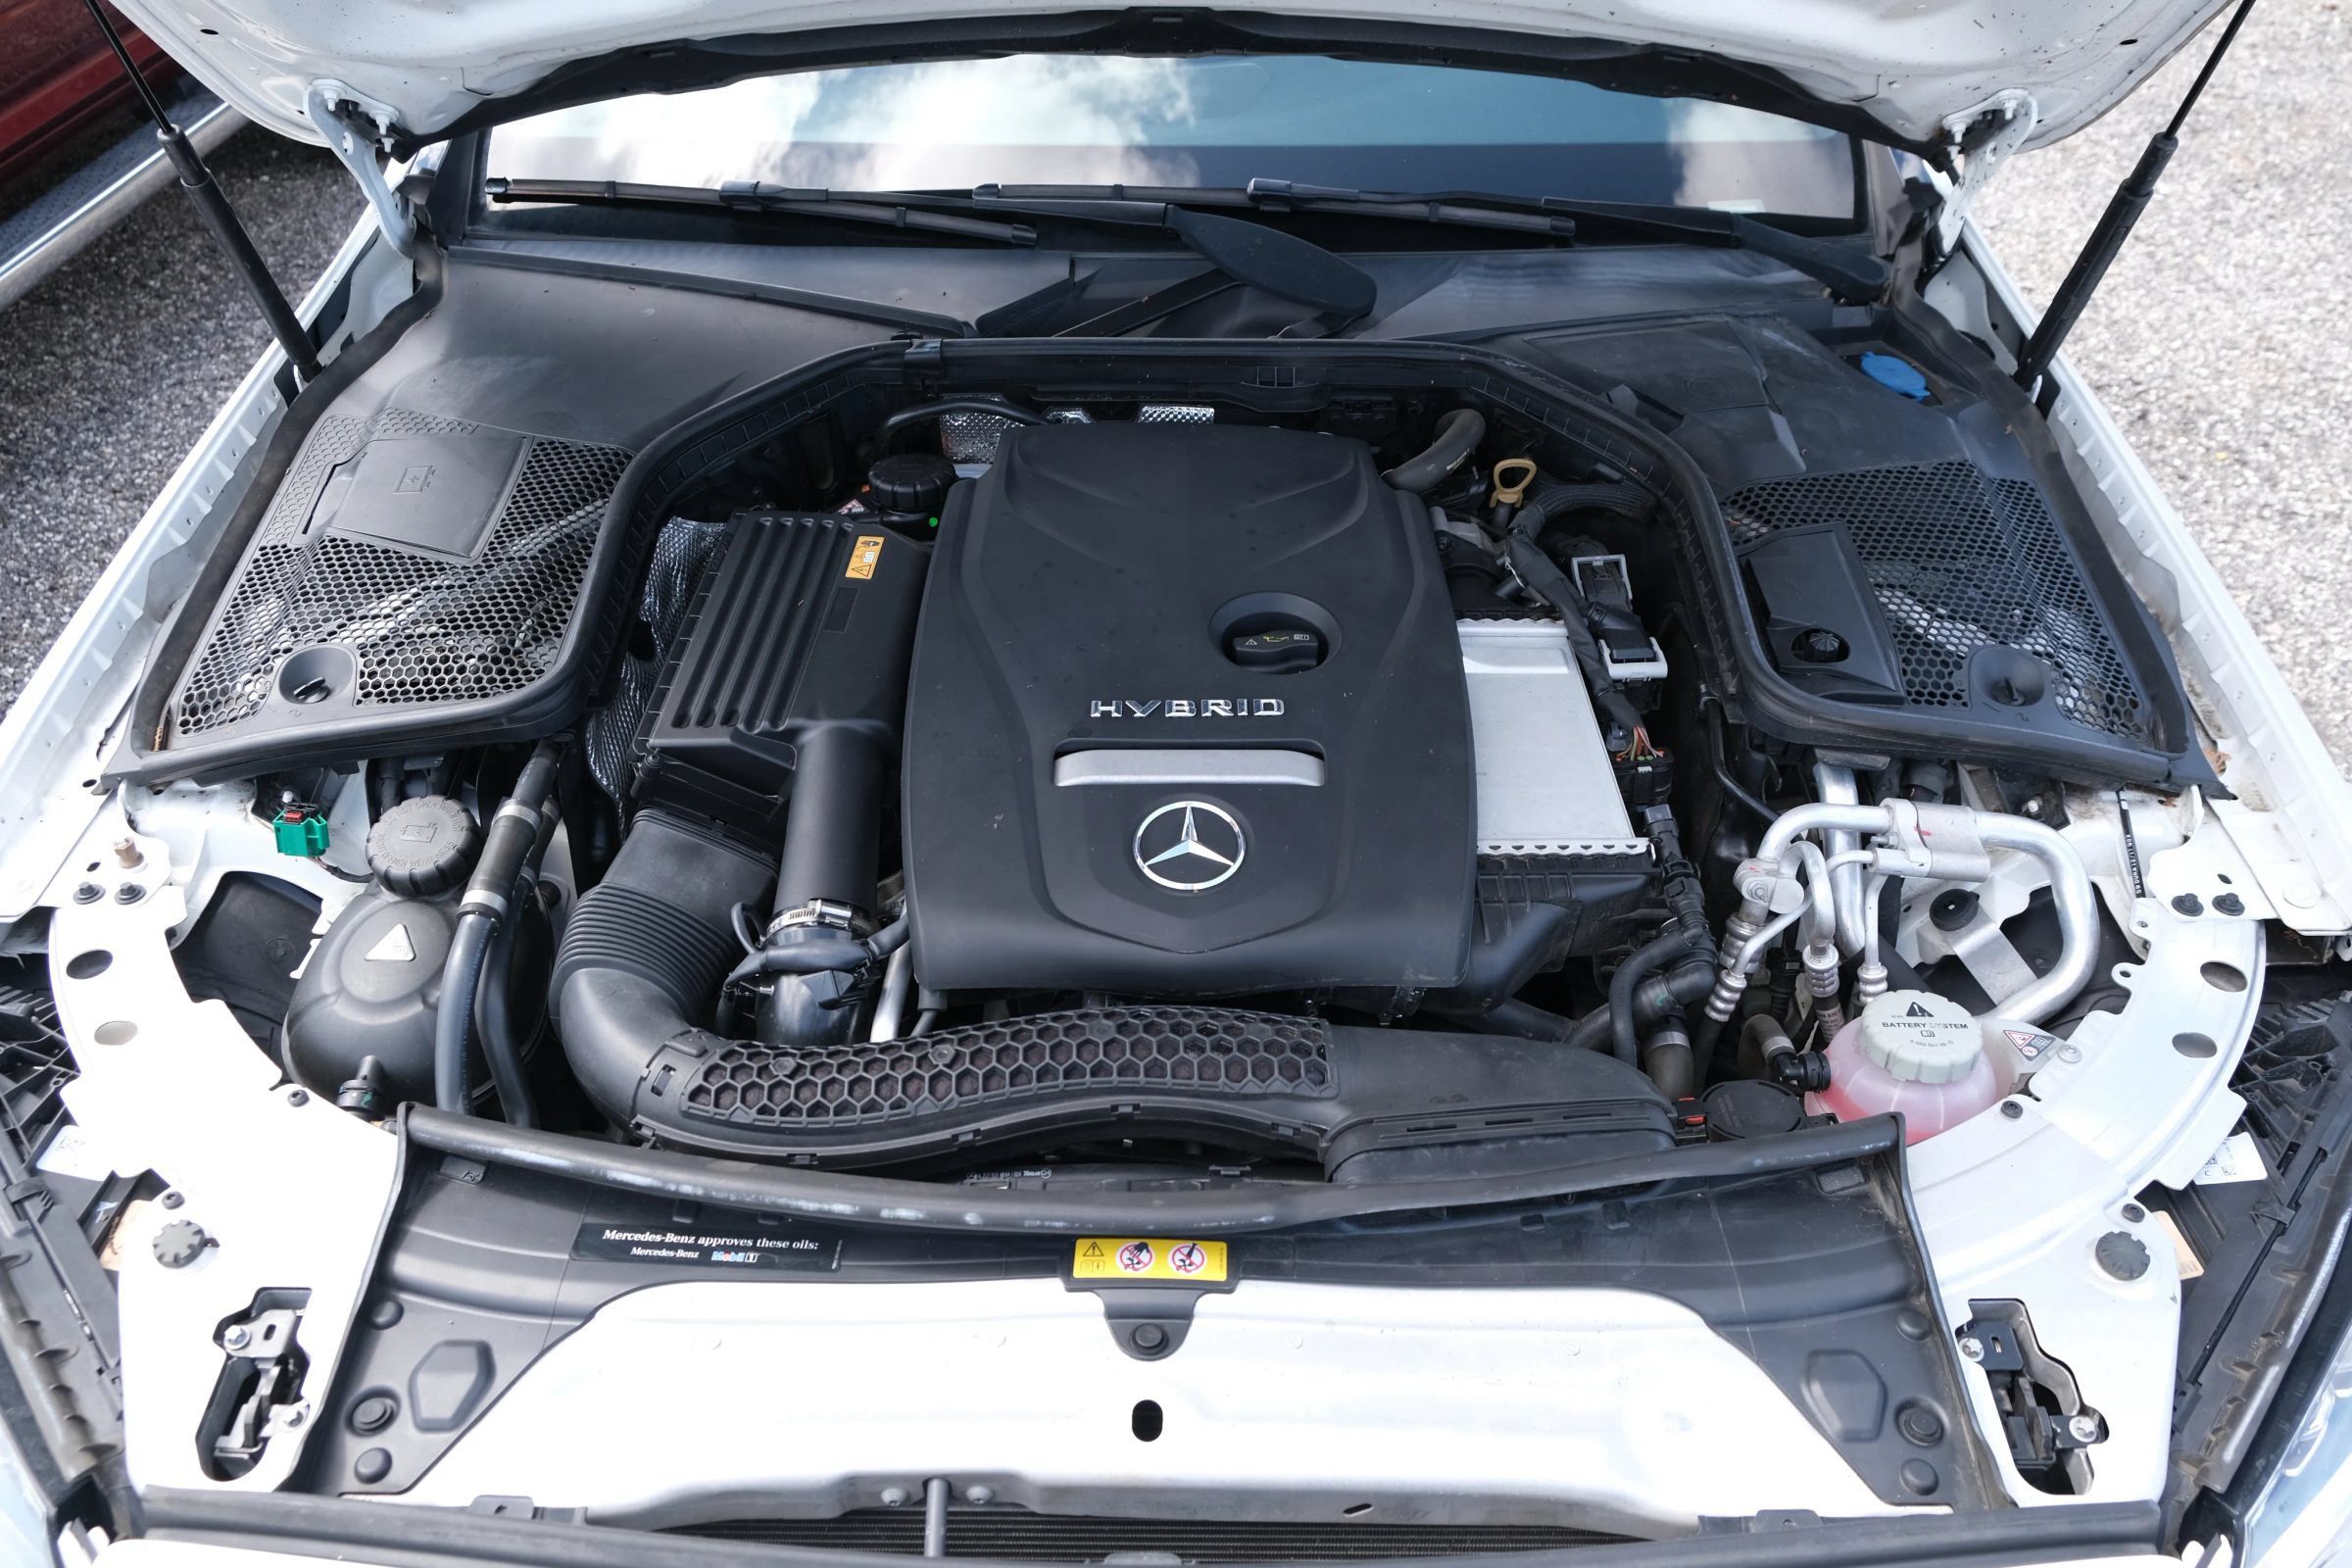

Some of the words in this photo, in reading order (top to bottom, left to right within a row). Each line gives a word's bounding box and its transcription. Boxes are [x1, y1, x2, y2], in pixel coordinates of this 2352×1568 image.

[1091, 699, 1285, 717] HYBRID
[602, 1229, 697, 1245] Mercedes-Benz
[697, 1236, 754, 1248] approves
[756, 1238, 790, 1249] these
[792, 1240, 819, 1250] oils:
[630, 1247, 700, 1258] Mercedes-Benz
